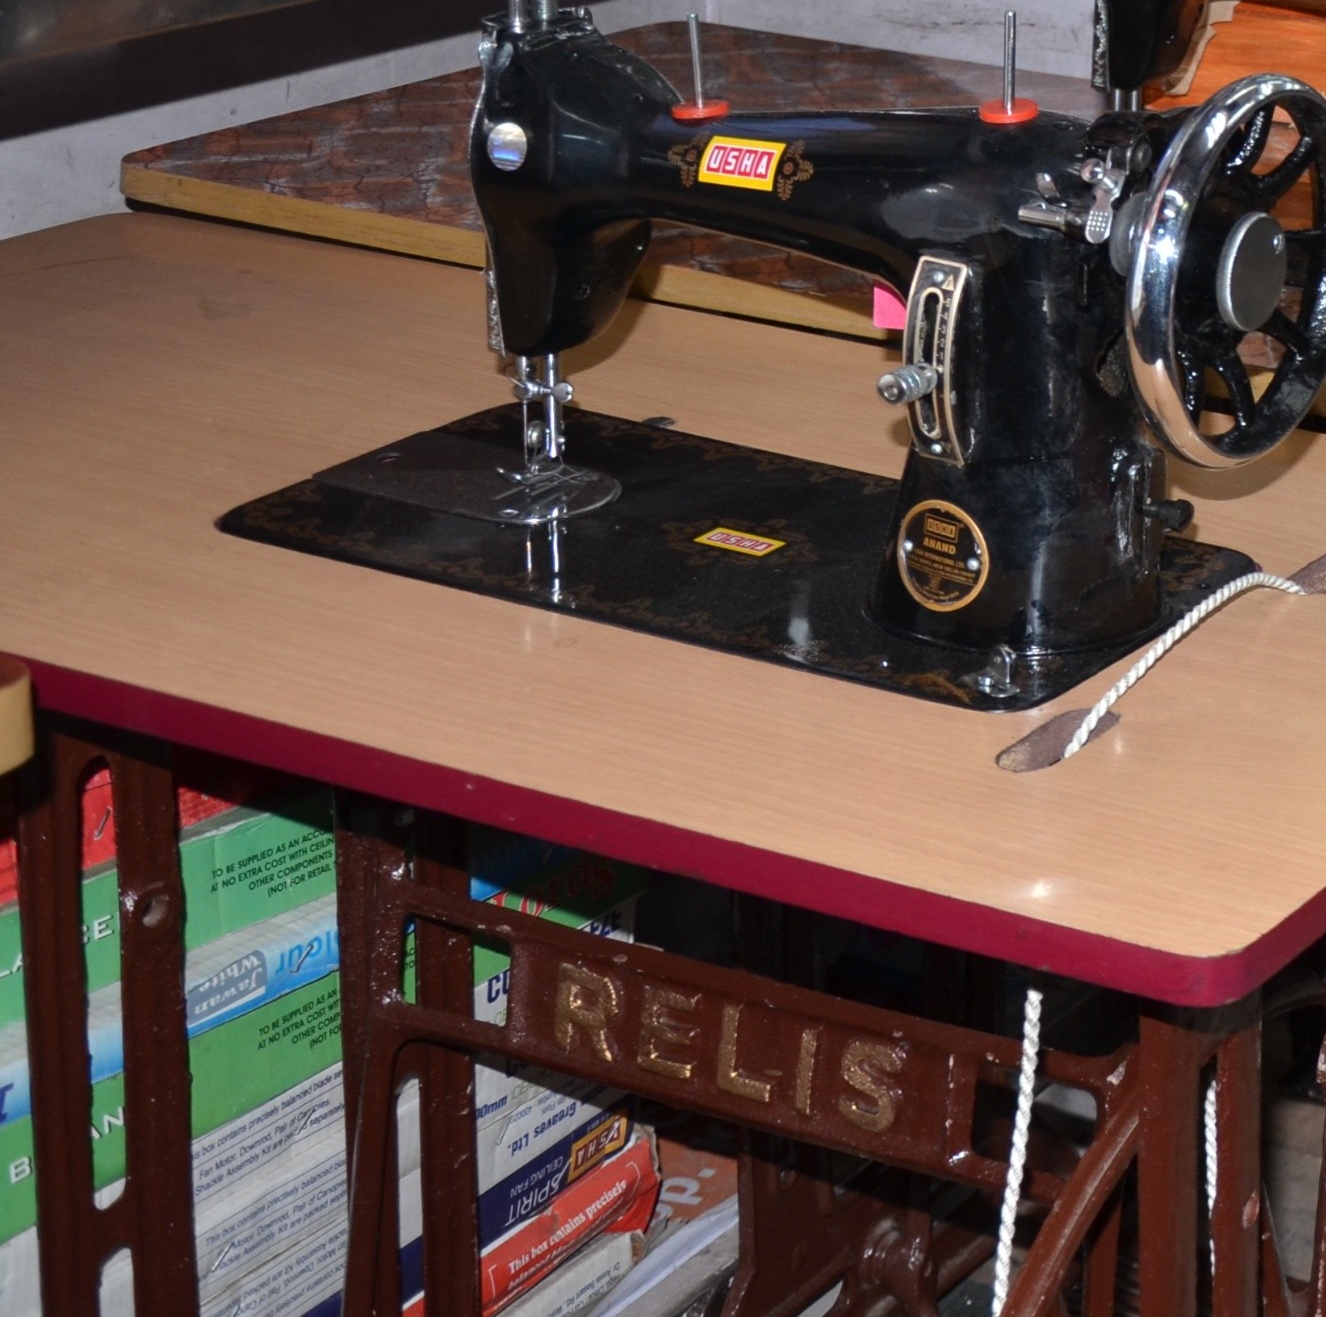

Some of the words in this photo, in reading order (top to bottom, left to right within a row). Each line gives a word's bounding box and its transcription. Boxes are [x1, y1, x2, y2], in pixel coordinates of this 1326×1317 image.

[707, 143, 771, 179] USHA
[707, 528, 777, 555] USHA
[923, 537, 957, 555] ANAND
[212, 868, 223, 879] TO
[226, 863, 236, 874] BE
[238, 848, 274, 869] SUPPLIED
[275, 843, 287, 854] AS
[288, 839, 299, 849] AN
[222, 876, 236, 889] NO
[238, 866, 263, 883] EXTRA
[264, 855, 287, 871] COST
[289, 847, 308, 861] WITH
[248, 873, 274, 891] OTHER
[276, 849, 333, 879] COMPONENTS
[267, 881, 287, 898] (NOT
[290, 874, 306, 887] FOR
[308, 863, 332, 880] RETAIL
[194, 968, 263, 1015] Jawan
[199, 954, 261, 992] White
[257, 1040, 266, 1051] AT
[268, 1032, 281, 1044] NO
[282, 1020, 305, 1037] EXTRA
[306, 1008, 326, 1024] COST
[259, 1025, 270, 1036] TO
[271, 1019, 280, 1029] BE
[282, 1001, 314, 1025] SUPPLIED
[316, 995, 325, 1006] AS
[327, 988, 337, 1000] AN
[292, 1027, 316, 1044] OTHER
[553, 962, 909, 1133] RELIS
[217, 1124, 247, 1147] contains
[281, 1085, 313, 1109] balanced
[534, 1101, 577, 1134] Greaves
[507, 1134, 530, 1157] Ltd.
[510, 1179, 530, 1198] FAN
[529, 1156, 564, 1184] CEILING
[505, 1162, 568, 1227] SPIRIT
[509, 1254, 529, 1275] This
[531, 1241, 549, 1259] box
[549, 1210, 586, 1246] contains
[585, 1179, 627, 1219] precisely
